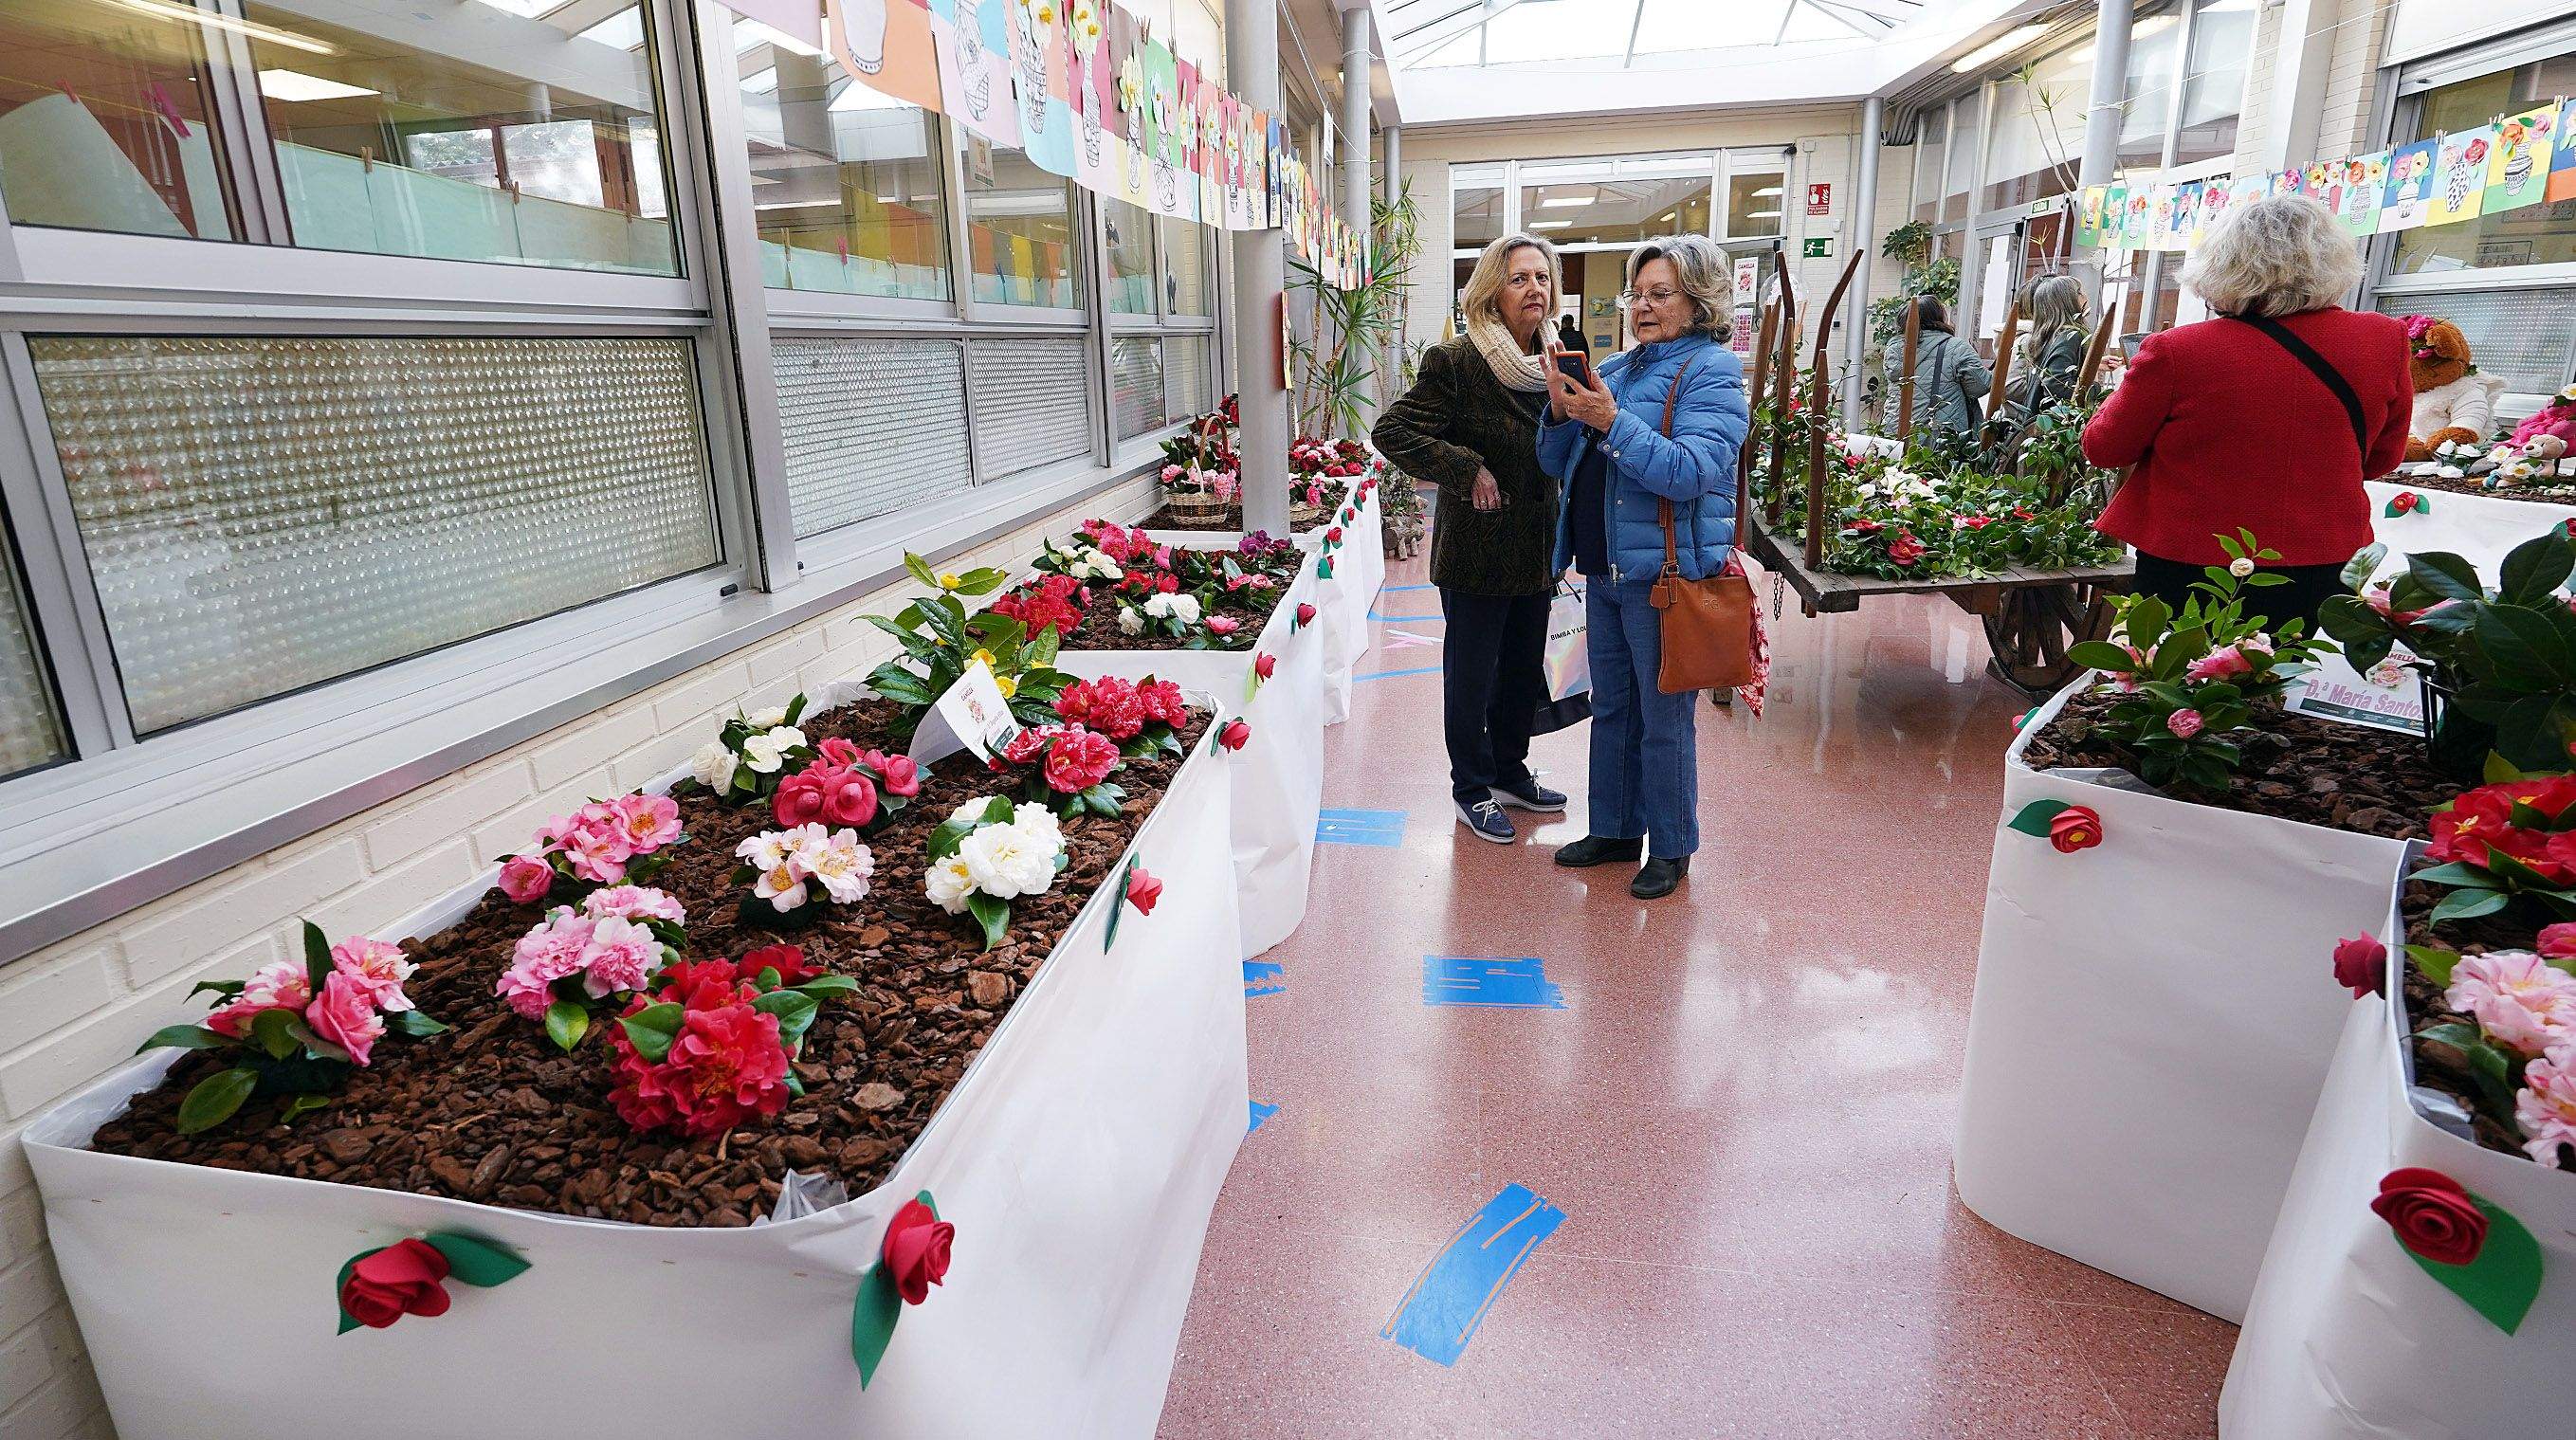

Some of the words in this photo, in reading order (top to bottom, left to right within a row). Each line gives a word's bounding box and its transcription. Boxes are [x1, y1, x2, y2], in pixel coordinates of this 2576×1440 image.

[1551, 630, 1570, 640] BIMBA
[2387, 653, 2416, 662] MELIA
[2328, 684, 2372, 708] María
